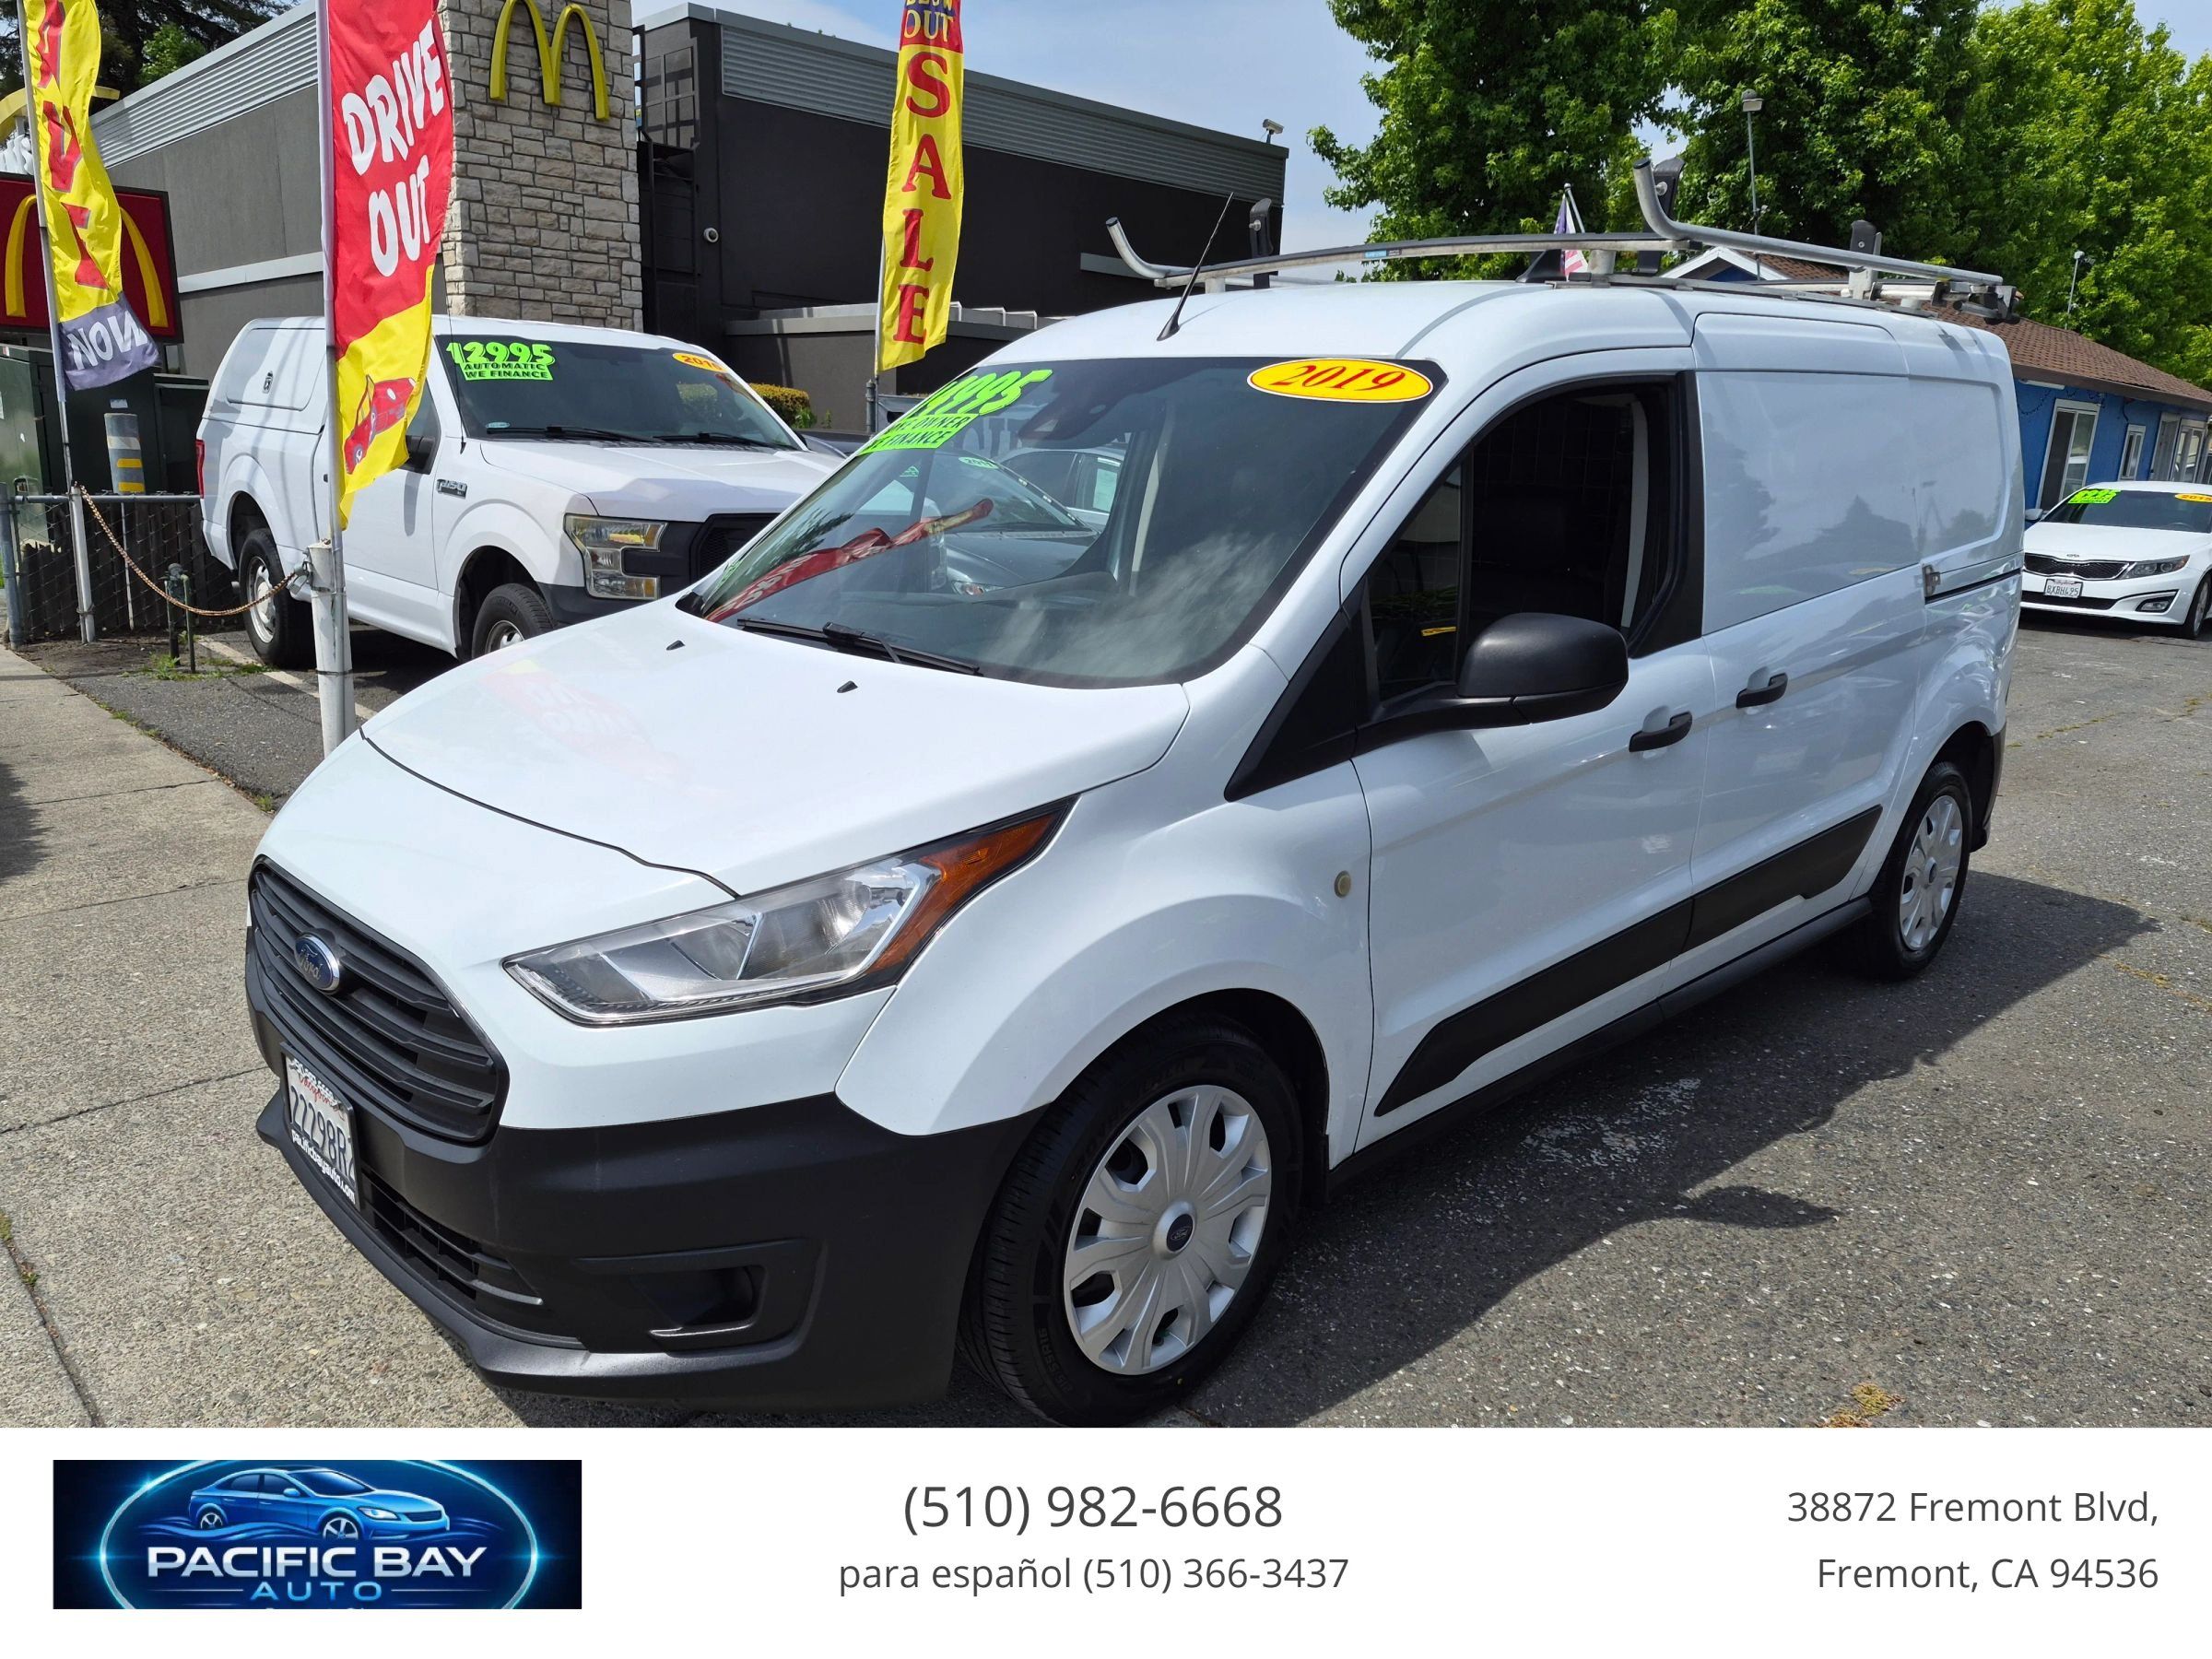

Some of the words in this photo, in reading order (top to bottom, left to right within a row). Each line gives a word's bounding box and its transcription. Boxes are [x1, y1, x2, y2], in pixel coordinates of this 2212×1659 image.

[903, 9, 954, 42] OUT
[341, 19, 444, 176] DRIVE
[892, 51, 952, 346] SALE
[369, 155, 430, 277] OUT
[66, 310, 148, 371] NOW
[446, 342, 555, 365] 12995
[464, 362, 546, 371] AUTOMATIC
[465, 371, 487, 379] WE
[490, 371, 548, 379] FINANCE
[681, 355, 724, 371] 201
[1269, 365, 1406, 392] 2019
[884, 430, 952, 446] FINANCE
